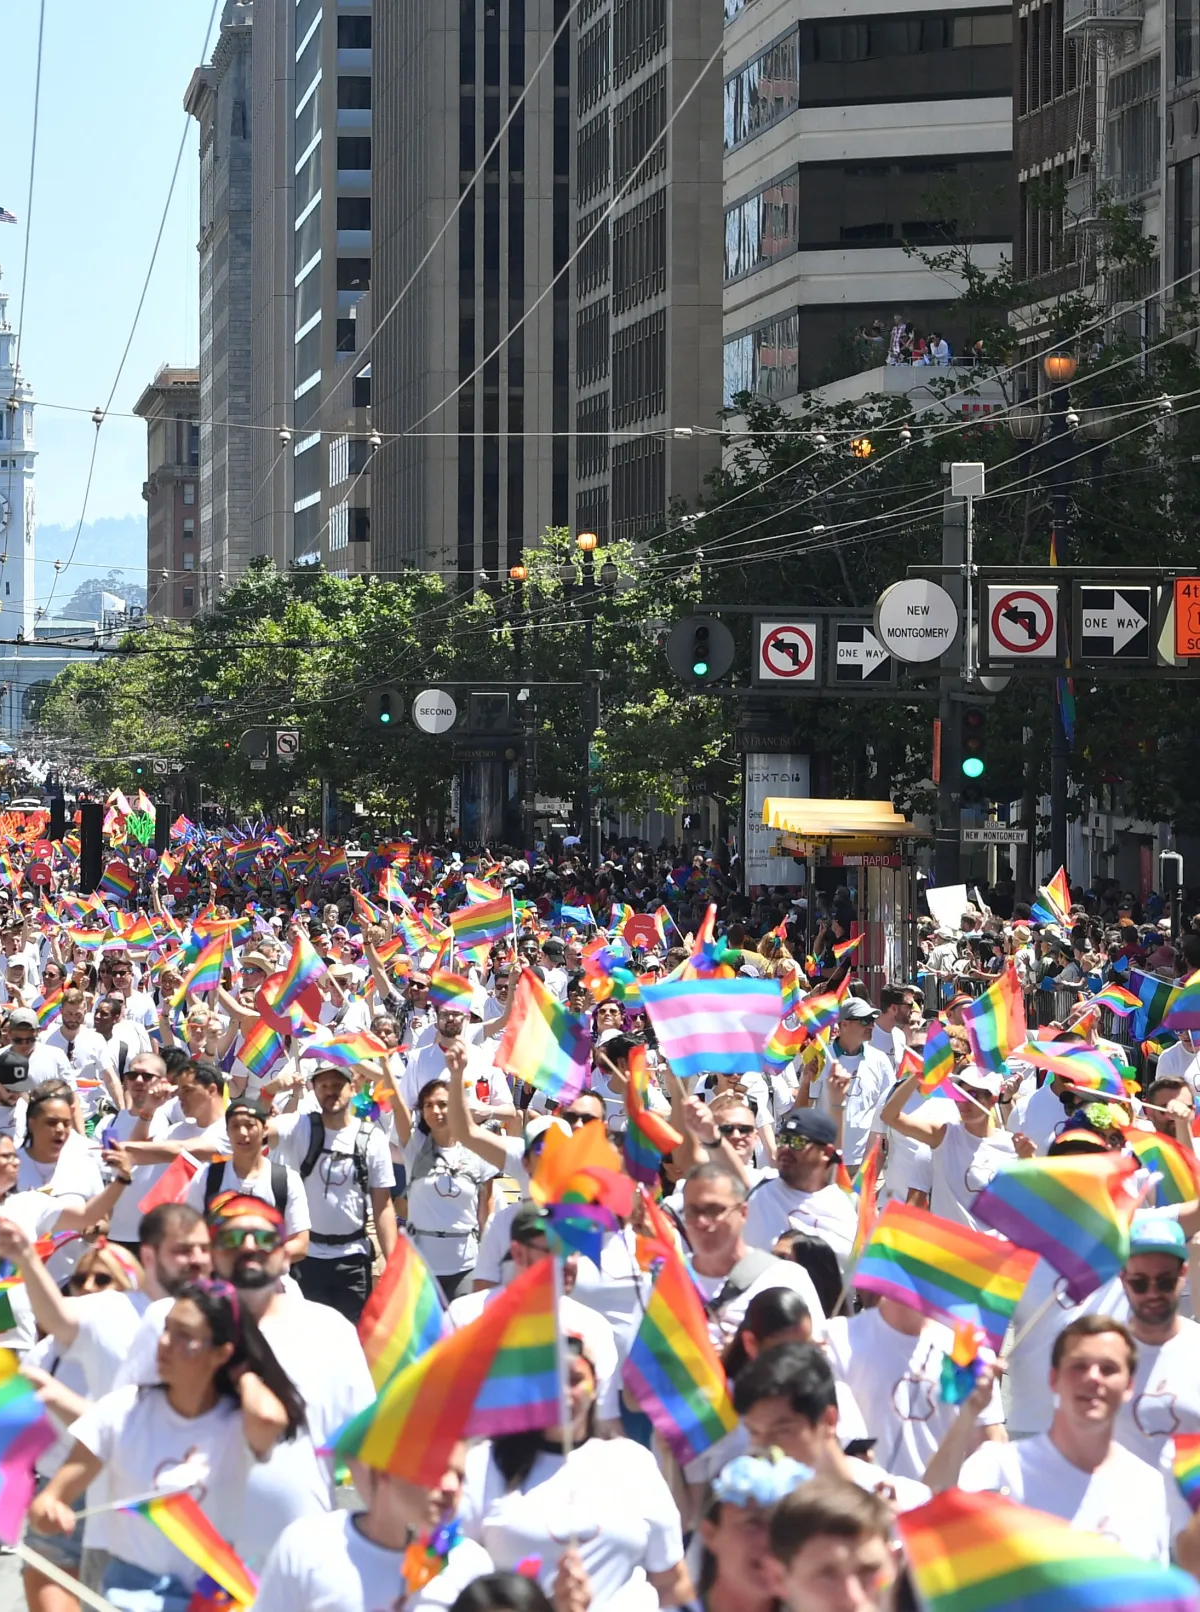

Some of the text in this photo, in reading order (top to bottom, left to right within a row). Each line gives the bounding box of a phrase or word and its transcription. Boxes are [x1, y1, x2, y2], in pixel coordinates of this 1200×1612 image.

[907, 605, 930, 616] NEW
[1084, 618, 1141, 629] ONE WAY
[887, 627, 949, 638] MONTGOMERY
[838, 648, 885, 659] ONE WAY
[419, 707, 452, 716] SECOND
[748, 773, 779, 783] NEXT
[748, 809, 762, 818] Gee
[965, 831, 1025, 841] NEW MONTGOMERY
[863, 855, 890, 866] RAPID
